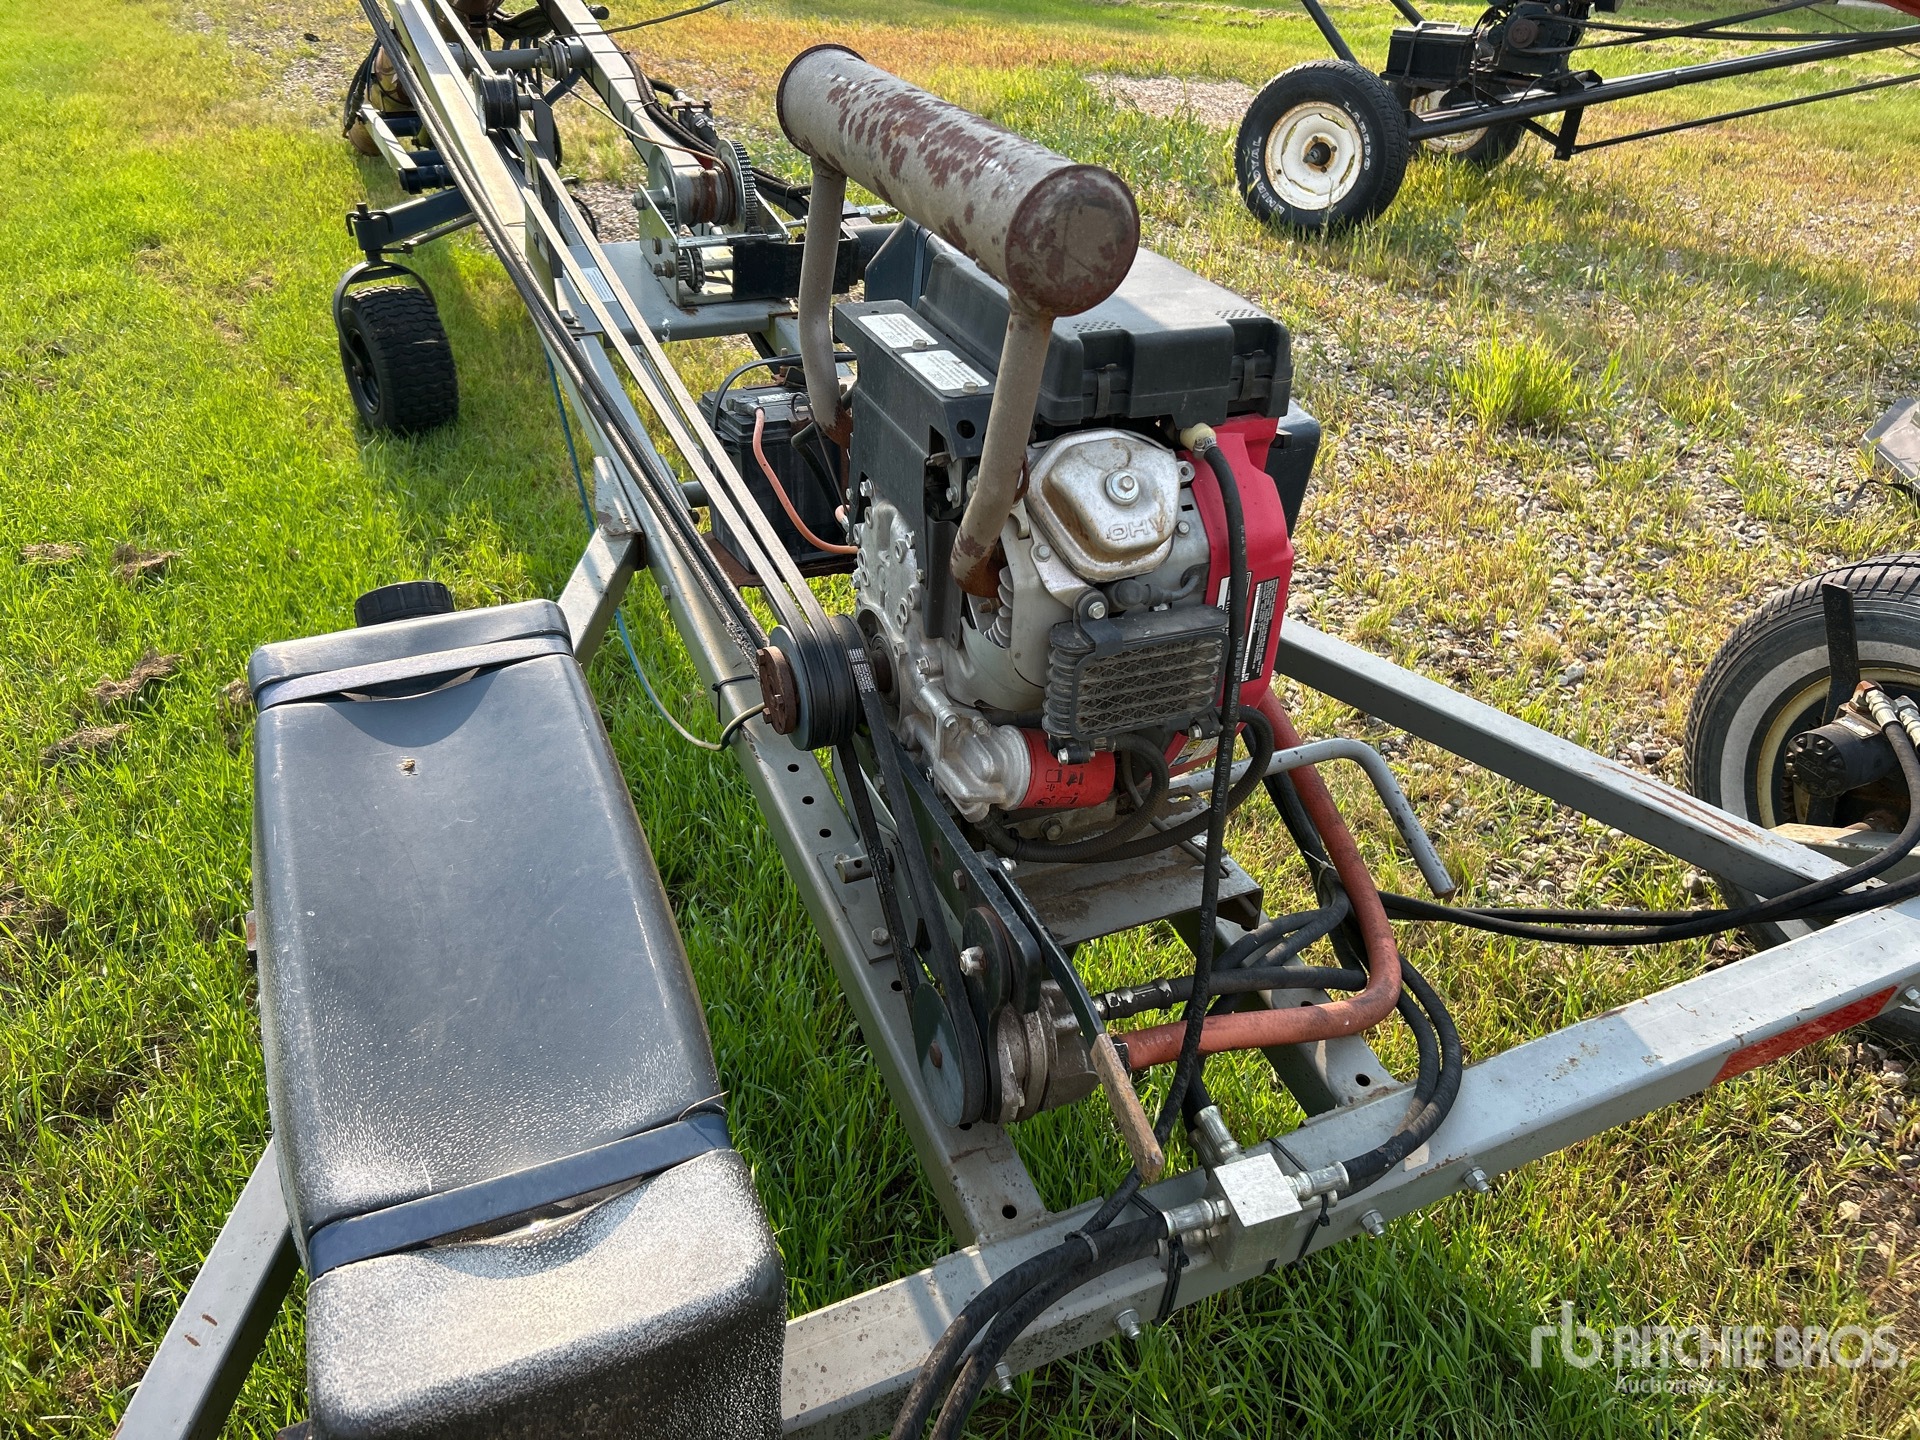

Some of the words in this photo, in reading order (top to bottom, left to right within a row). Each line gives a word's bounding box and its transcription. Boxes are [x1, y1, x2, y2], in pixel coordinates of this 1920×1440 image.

[1343, 101, 1371, 171] LAREDO
[1250, 136, 1285, 215] UNIROYAL
[1109, 515, 1165, 541] OHV
